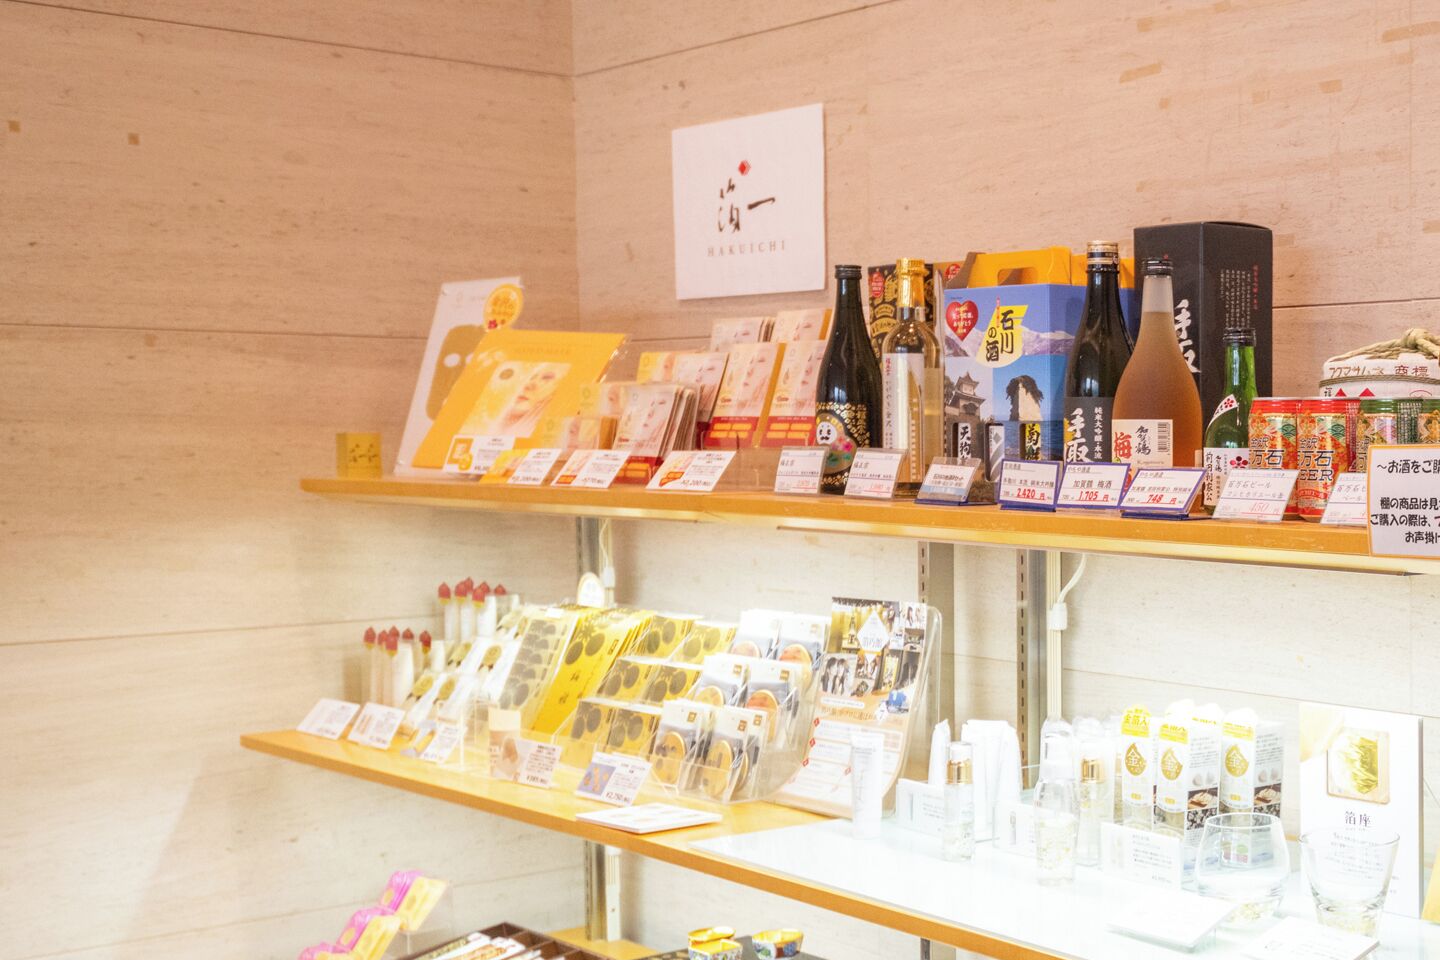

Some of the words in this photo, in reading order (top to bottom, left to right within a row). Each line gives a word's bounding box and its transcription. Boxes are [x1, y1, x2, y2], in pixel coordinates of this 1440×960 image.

[707, 239, 786, 257] HAKUICHI
[959, 426, 971, 460] 天狗
[1298, 450, 1334, 467] 万石
[1300, 469, 1333, 481] EER
